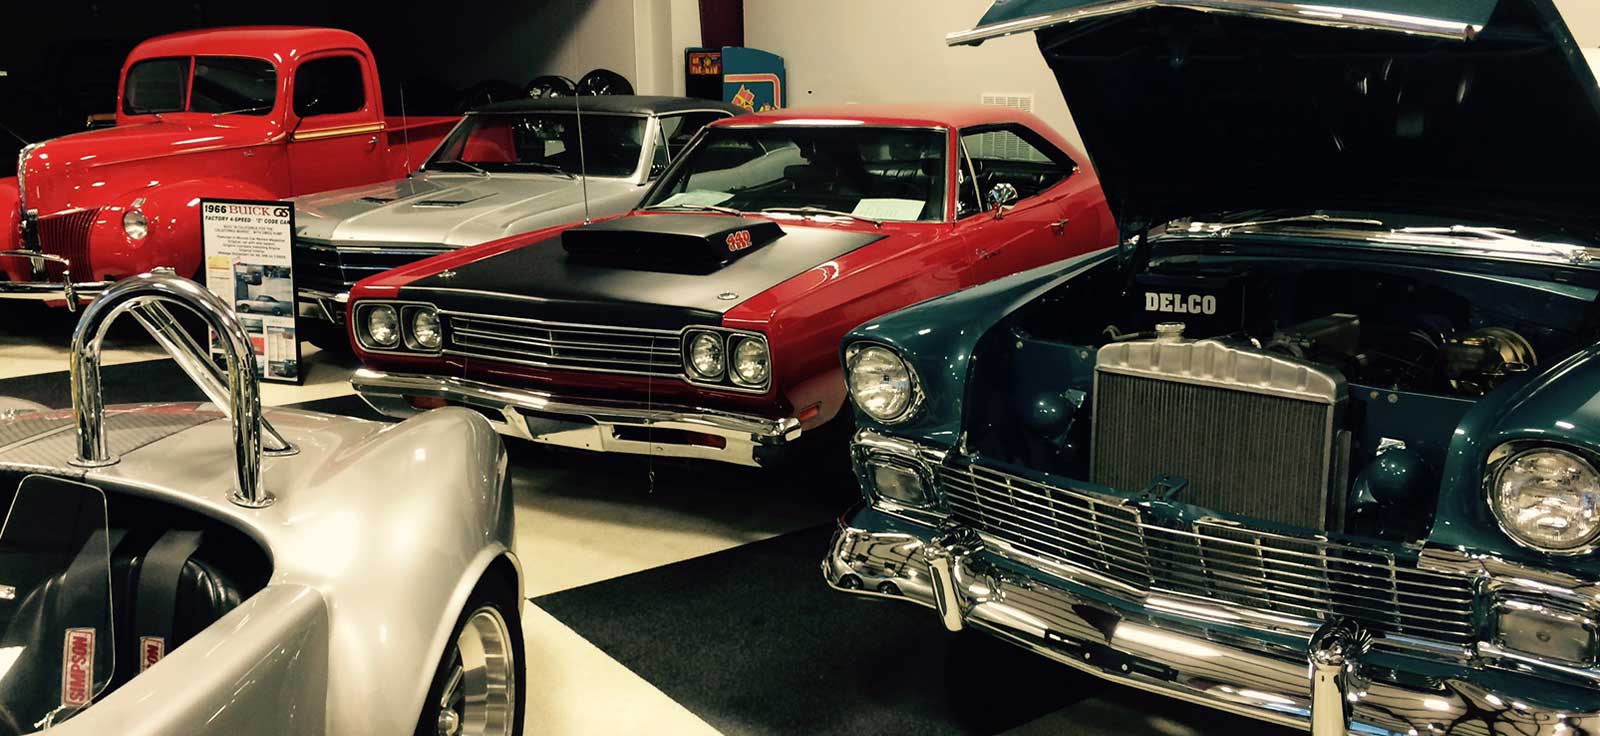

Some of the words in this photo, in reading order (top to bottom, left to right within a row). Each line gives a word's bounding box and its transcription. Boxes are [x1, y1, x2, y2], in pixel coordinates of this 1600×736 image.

[205, 204, 227, 213] 1966
[229, 206, 271, 216] BUICK
[273, 208, 290, 217] GS
[726, 230, 751, 244] 440
[1145, 292, 1216, 315] DELCO
[69, 636, 88, 701] SIMPSON
